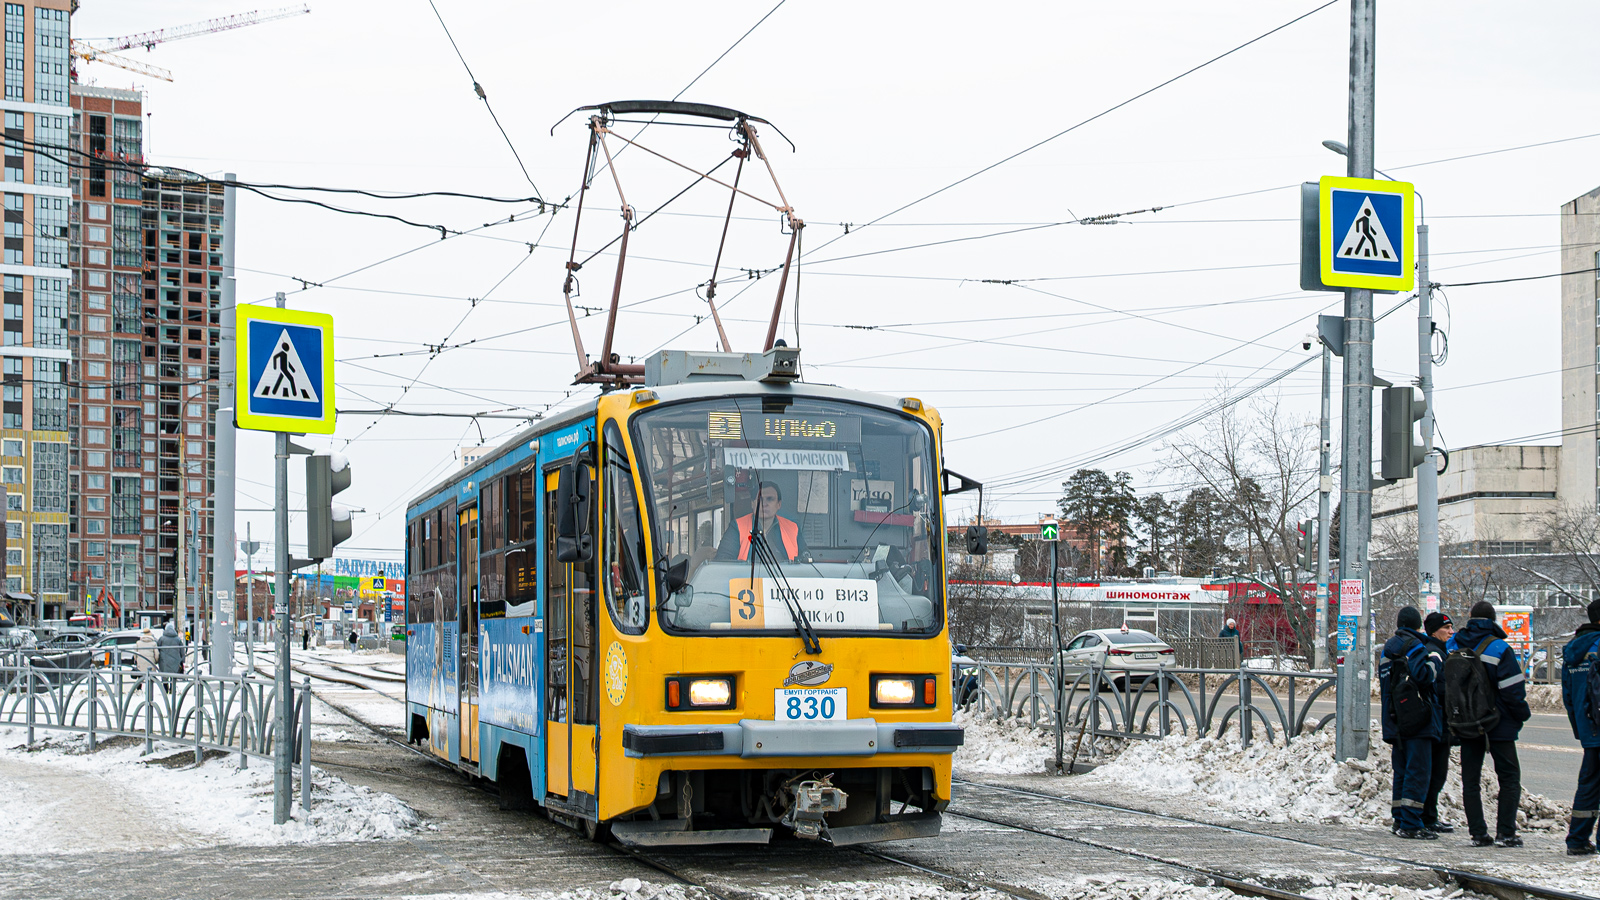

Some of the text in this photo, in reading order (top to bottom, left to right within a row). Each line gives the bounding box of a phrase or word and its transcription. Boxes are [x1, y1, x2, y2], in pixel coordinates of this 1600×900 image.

[765, 419, 836, 440] ЦПКиО
[738, 589, 756, 620] 3
[836, 589, 868, 602] ВИЗ
[632, 601, 640, 626] 3
[493, 643, 533, 686] TALISMAN
[786, 696, 835, 719] 830
